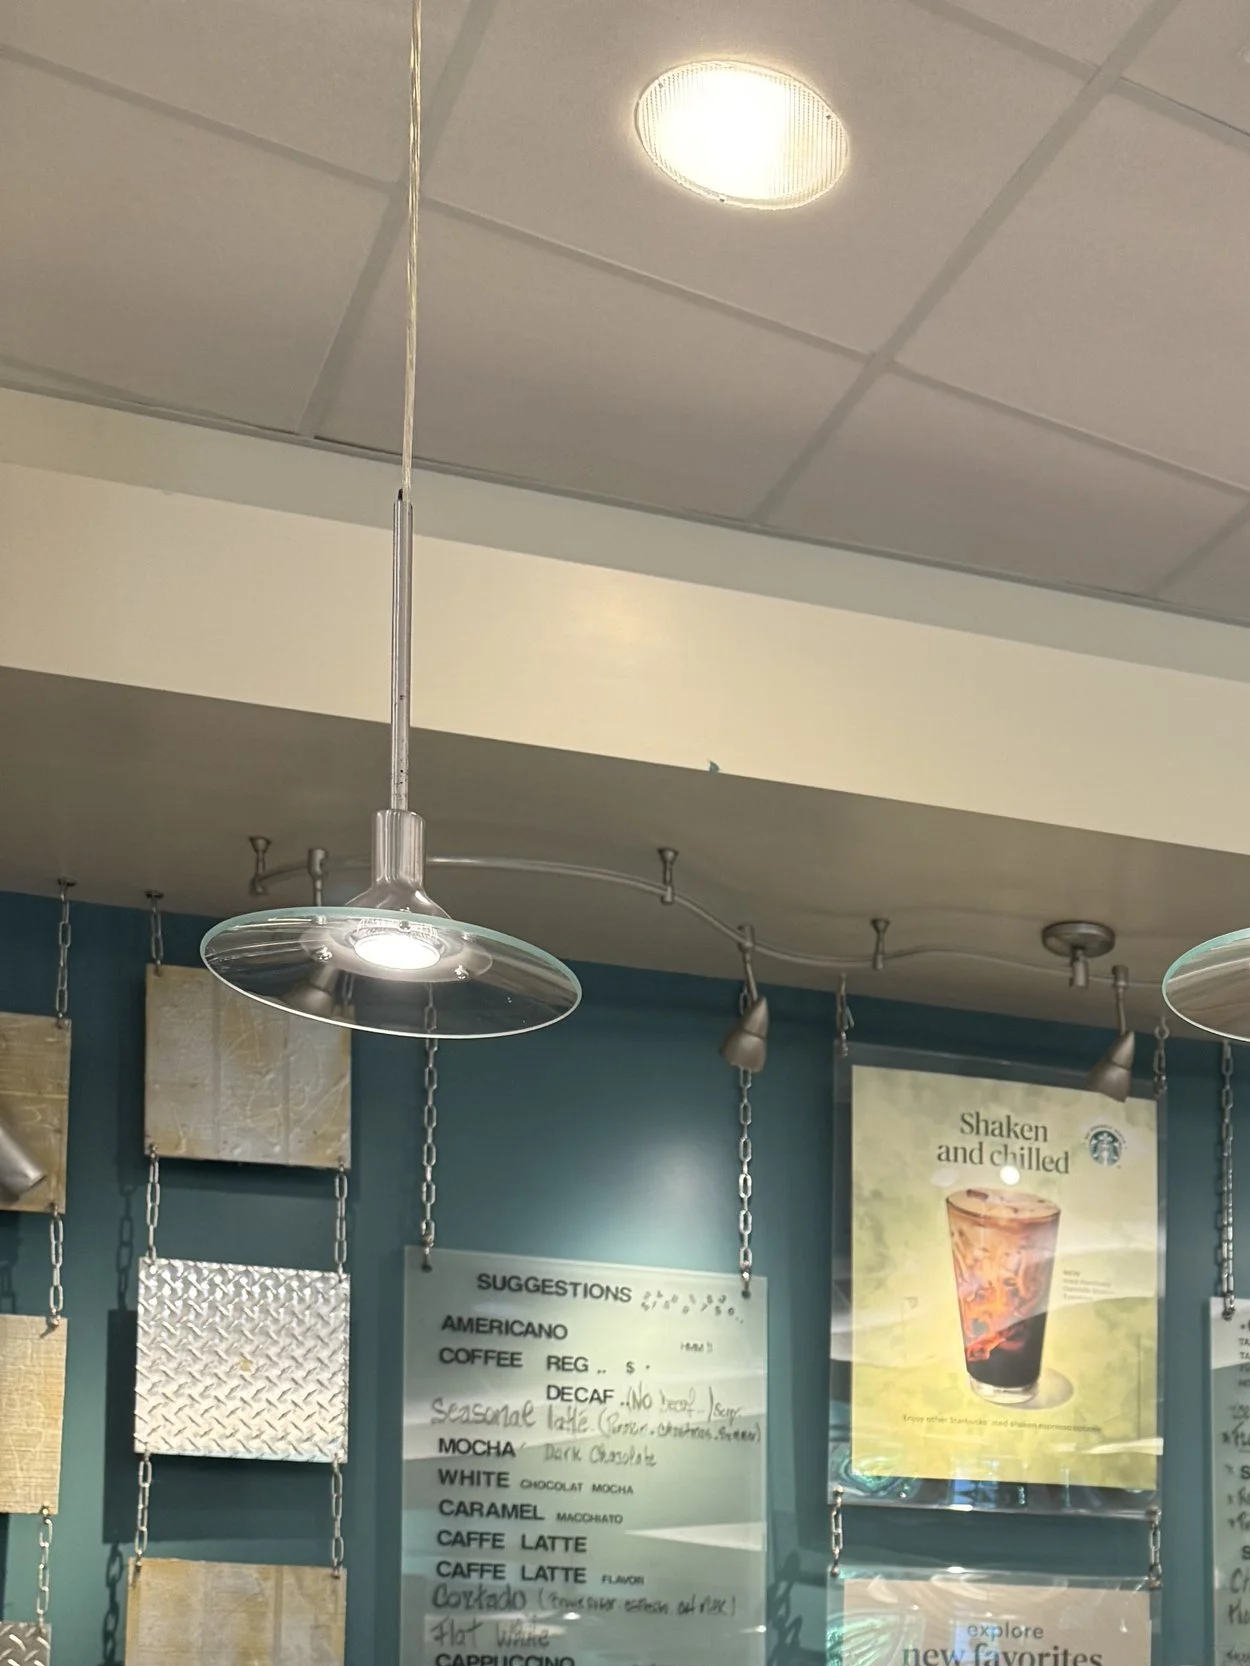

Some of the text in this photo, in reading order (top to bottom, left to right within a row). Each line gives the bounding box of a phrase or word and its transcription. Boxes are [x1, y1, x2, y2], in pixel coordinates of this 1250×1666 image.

[961, 1112, 1048, 1143] Shaken
[937, 1142, 1070, 1175] and chilled
[477, 1273, 633, 1303] SUGGESTIONS
[441, 1315, 569, 1341] AMERICANO
[439, 1347, 524, 1369] COFFEE
[547, 1355, 589, 1374] REG
[546, 1384, 615, 1406] DECAF
[431, 1397, 537, 1431] Seasonal
[439, 1438, 516, 1457] MOCHA
[438, 1469, 634, 1495] WHITE CHOCOLAT MOCHA
[439, 1499, 623, 1525] CARAMEL MACCHIATO
[437, 1530, 587, 1553] CAFFE LATTE
[436, 1561, 644, 1586] CAFFE LATTE FLAVOR
[431, 1617, 483, 1648] Flat
[967, 1621, 1043, 1641] explore
